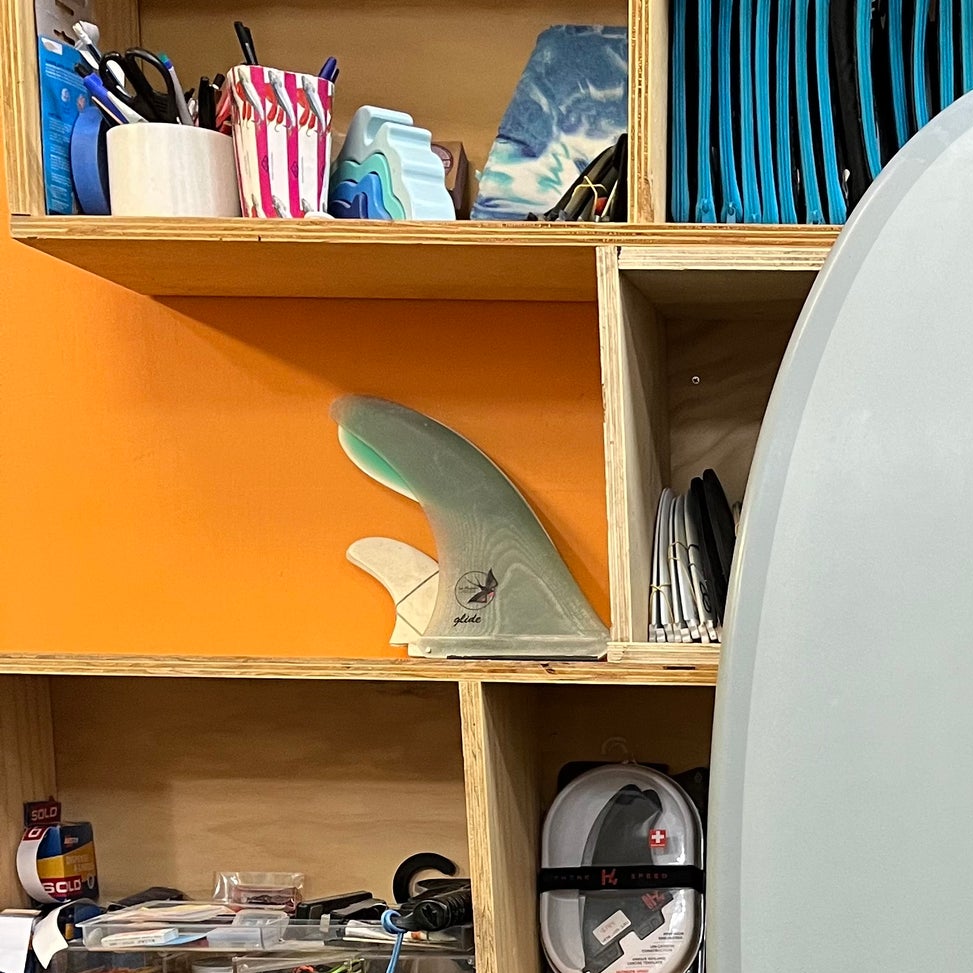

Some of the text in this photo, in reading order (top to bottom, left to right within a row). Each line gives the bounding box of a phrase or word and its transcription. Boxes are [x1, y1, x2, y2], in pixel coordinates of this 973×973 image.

[454, 613, 482, 628] glide
[31, 806, 57, 821] SOLD
[630, 873, 669, 881] SPEED
[43, 880, 82, 894] SOLD
